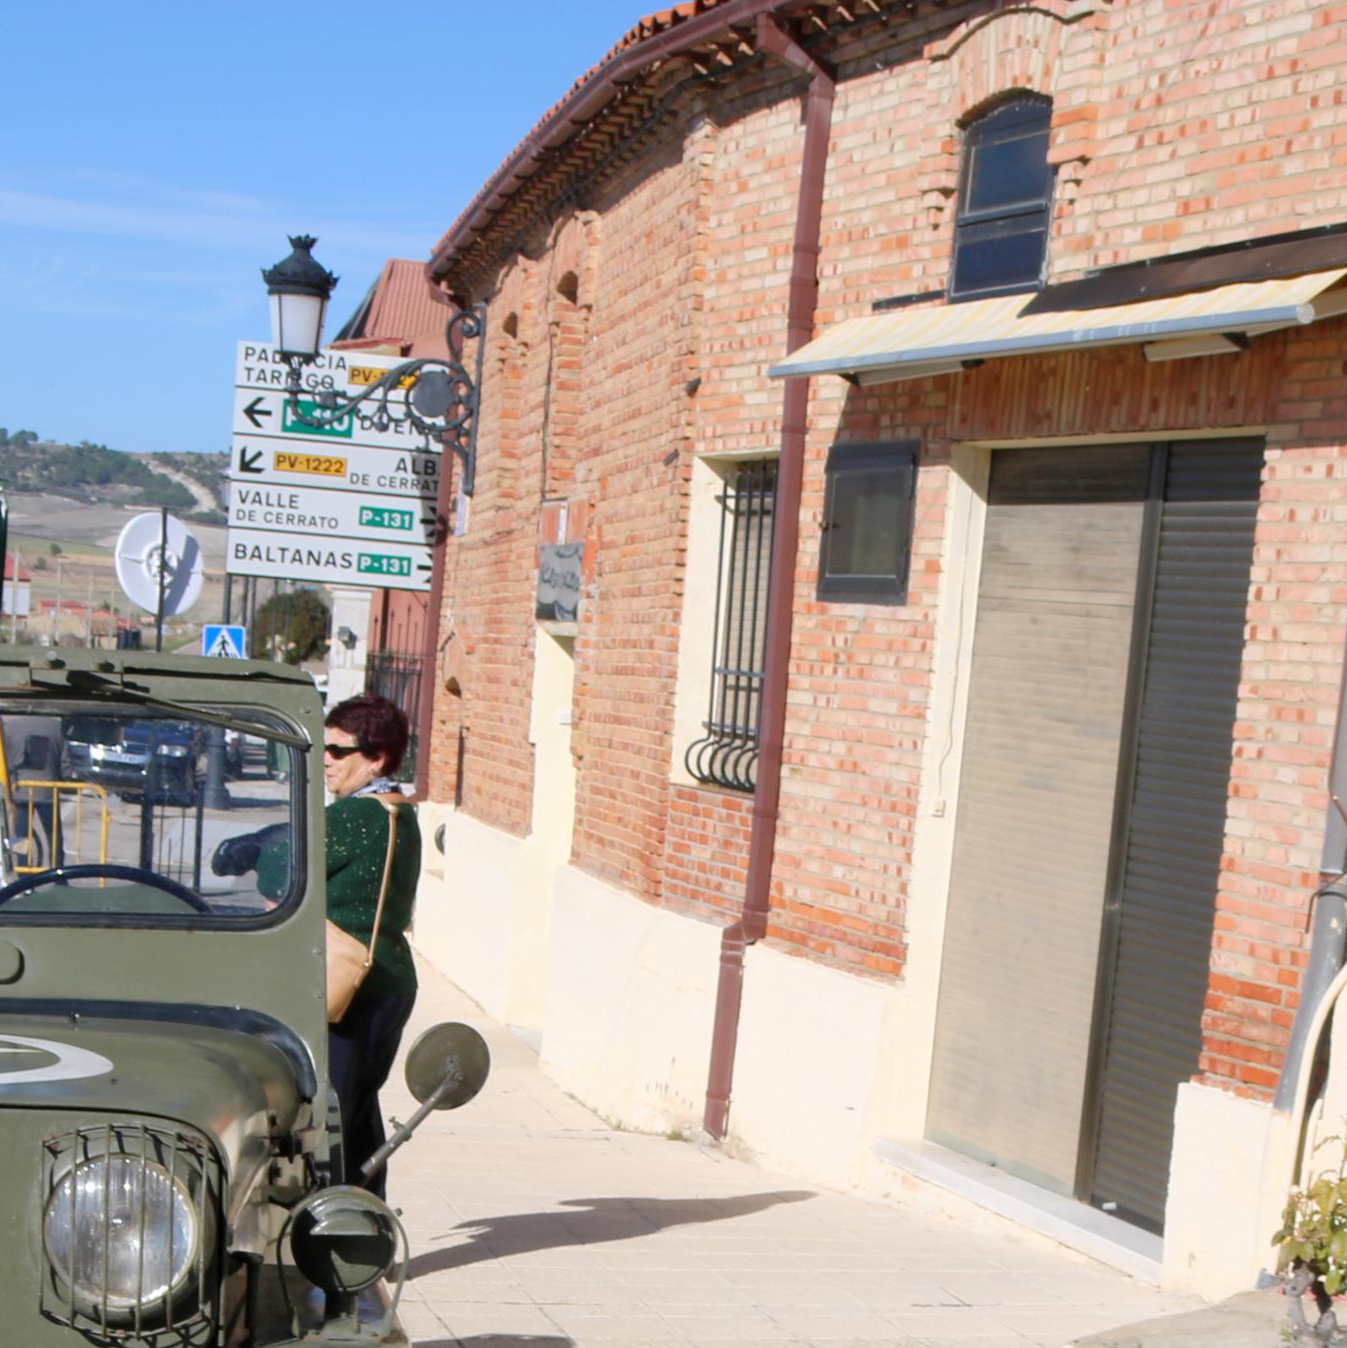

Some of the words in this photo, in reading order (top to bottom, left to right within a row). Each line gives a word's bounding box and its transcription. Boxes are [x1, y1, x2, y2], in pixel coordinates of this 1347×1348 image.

[244, 346, 347, 371] PALCIA
[244, 366, 334, 389] TARIGO
[275, 455, 344, 475] PV-1222
[395, 457, 439, 477] ALB
[349, 473, 369, 486] DE
[377, 475, 440, 492] CERRAT
[238, 489, 300, 509] VALLE
[236, 509, 256, 522] DE
[263, 511, 339, 530] CERRATO
[361, 509, 411, 529] P-131
[234, 543, 353, 569] BALTANAS
[359, 556, 410, 575] P-131
